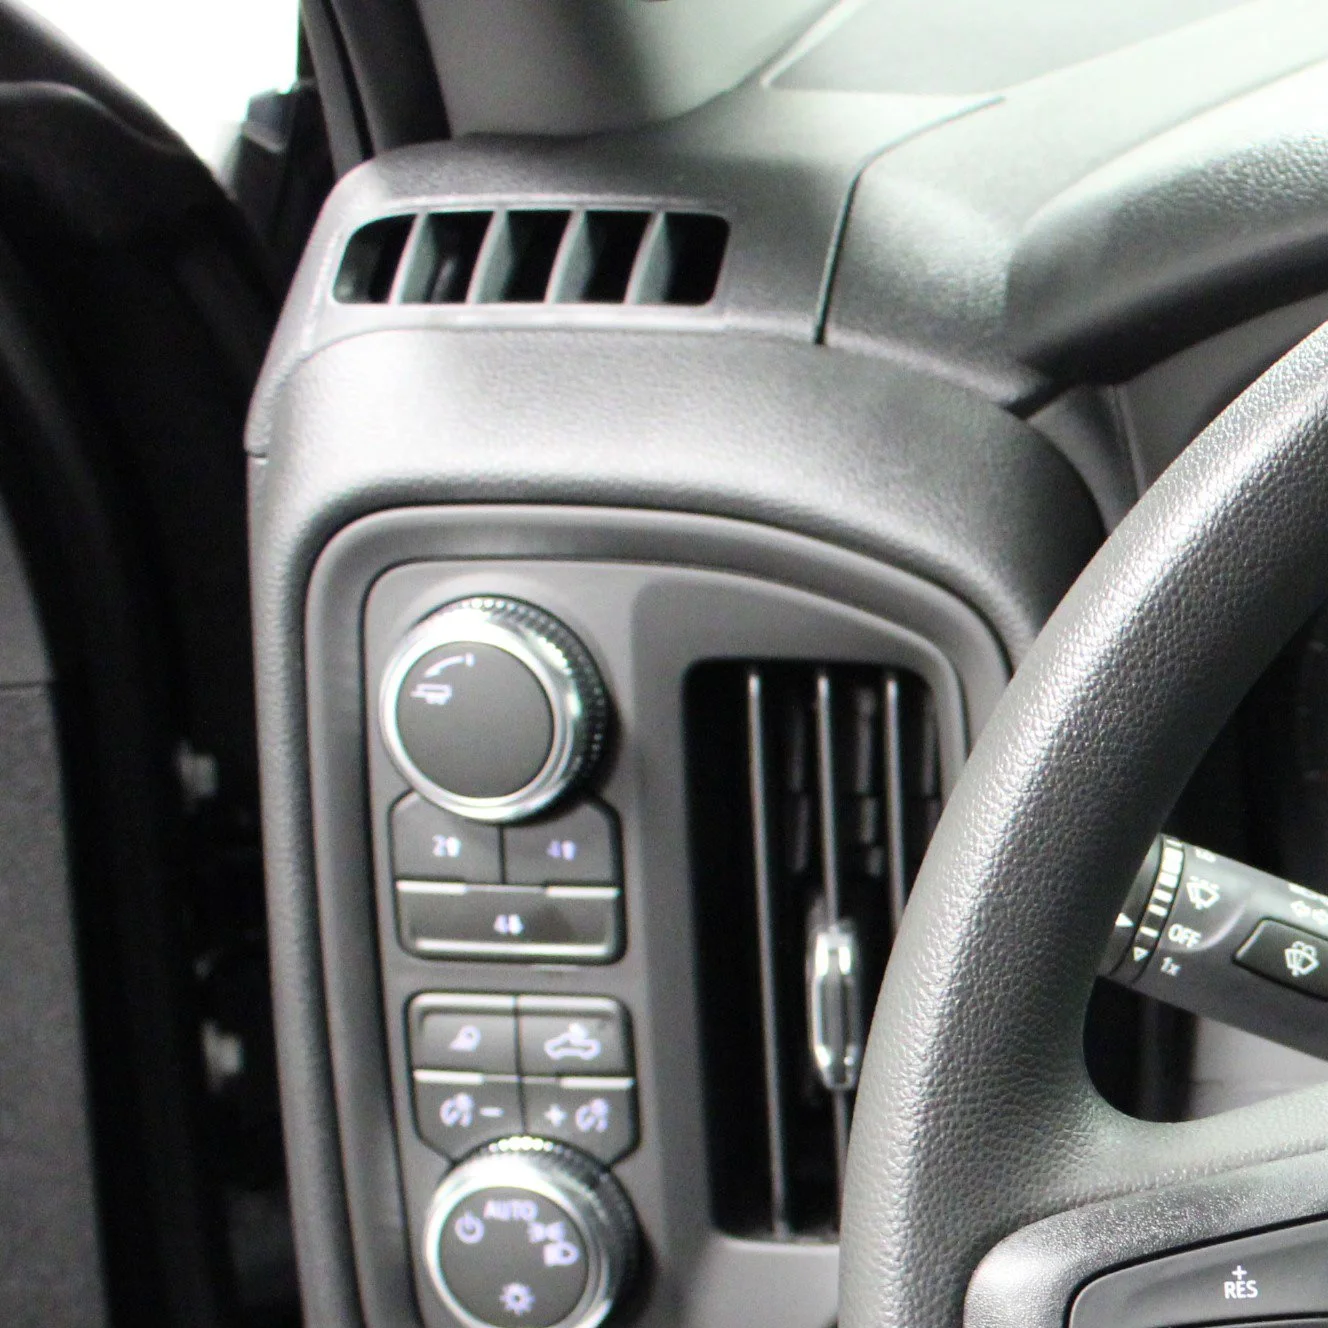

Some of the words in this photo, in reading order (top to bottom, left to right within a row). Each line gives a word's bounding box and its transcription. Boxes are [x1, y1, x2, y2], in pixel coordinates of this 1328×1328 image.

[1167, 923, 1202, 949] OFF
[483, 1199, 539, 1221] AUTO
[1223, 1280, 1259, 1300] RES
